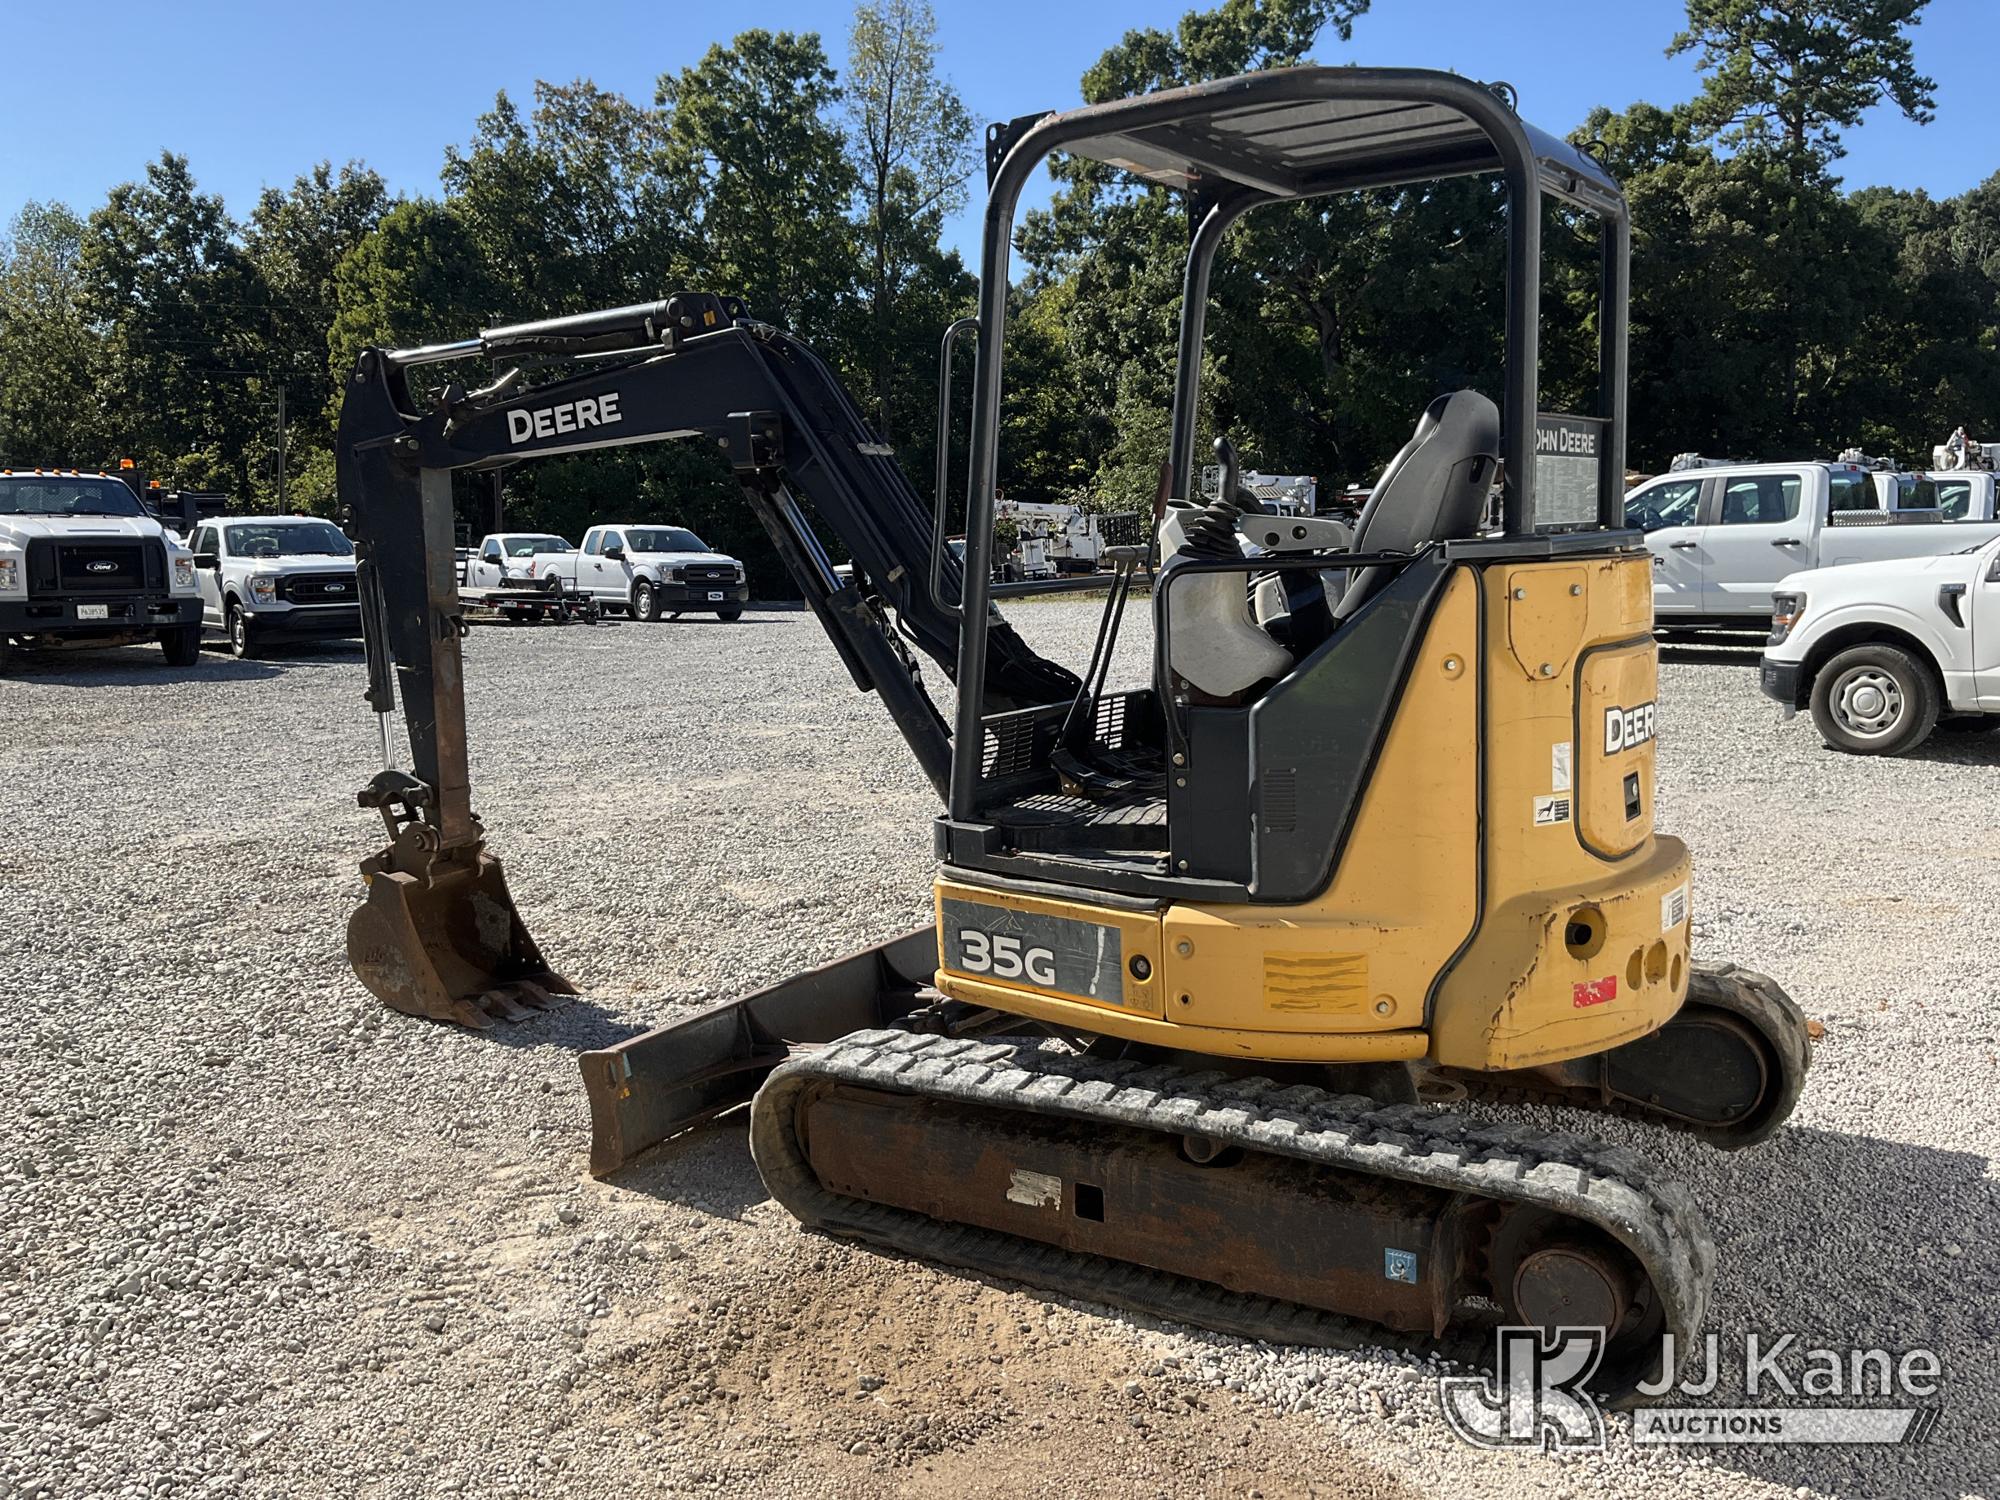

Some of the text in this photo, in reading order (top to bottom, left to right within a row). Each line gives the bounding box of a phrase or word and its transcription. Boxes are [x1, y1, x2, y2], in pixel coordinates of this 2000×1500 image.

[507, 393, 622, 444] DEERE
[1559, 427, 1595, 454] DEERE
[1605, 703, 1656, 754] DEER
[960, 930, 1056, 985] 35G
